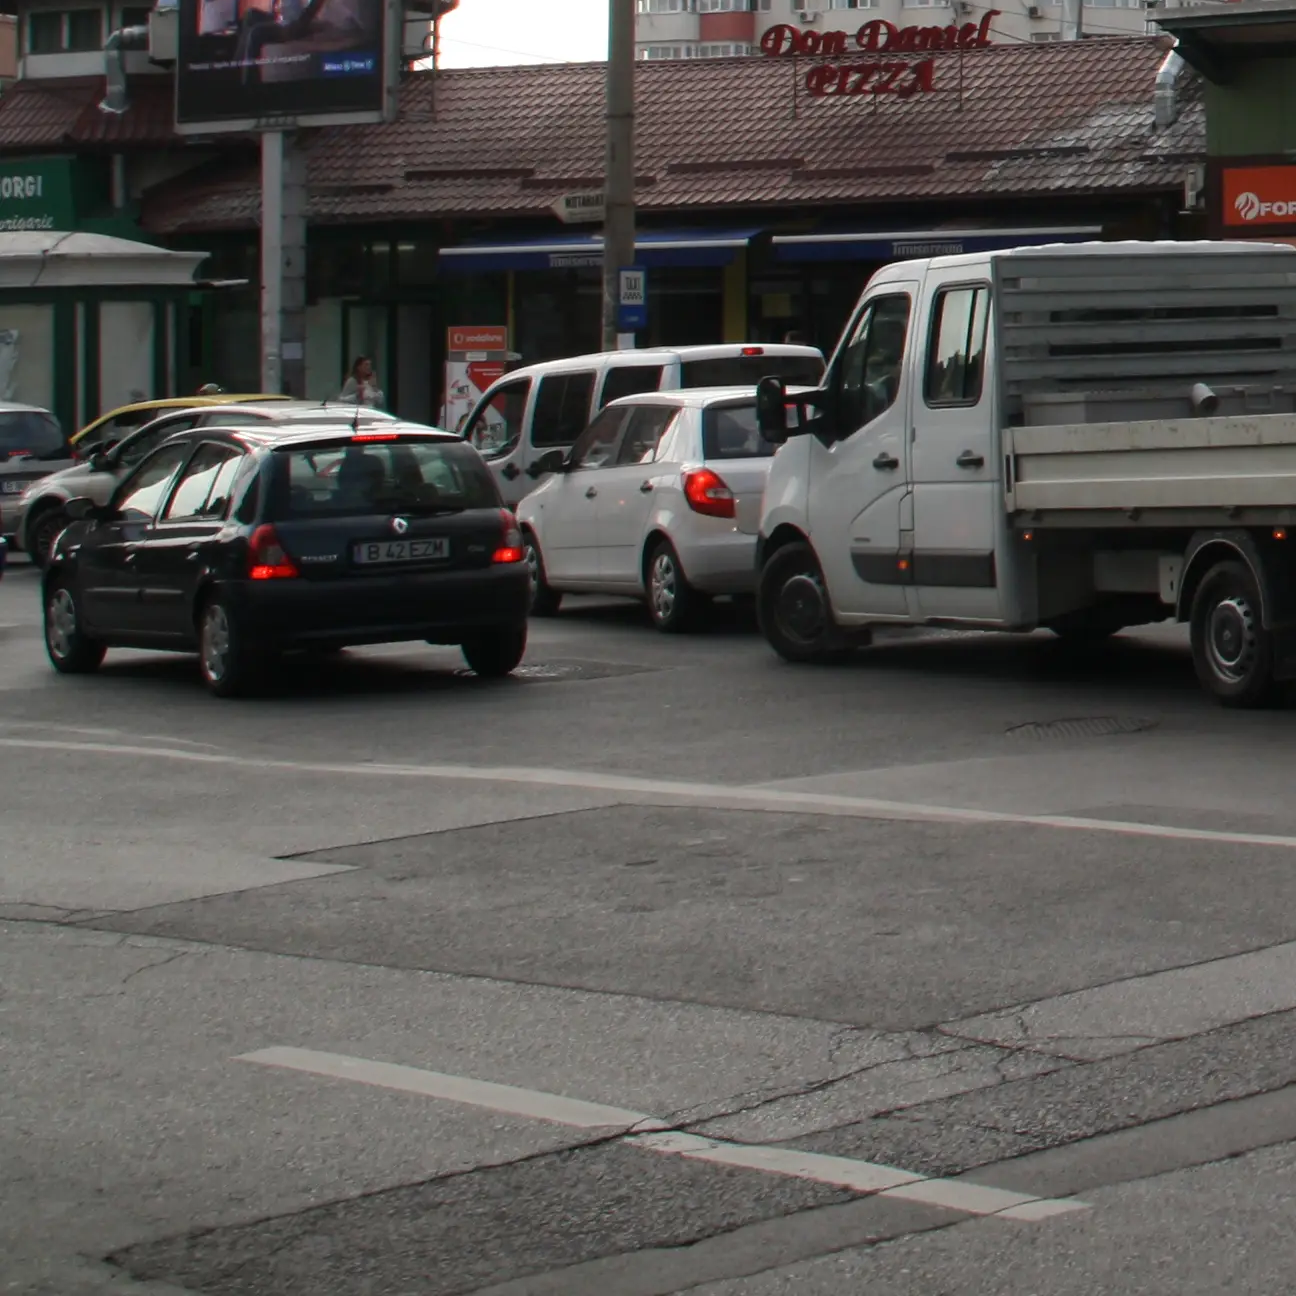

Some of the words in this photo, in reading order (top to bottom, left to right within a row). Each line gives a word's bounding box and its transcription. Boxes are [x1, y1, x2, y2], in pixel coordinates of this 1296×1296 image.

[760, 24, 849, 56] Don
[855, 9, 1002, 54] Daniel
[806, 58, 937, 97] PIZZA
[368, 544, 380, 561] B
[387, 543, 405, 560] 42
[410, 537, 443, 557] EZM
